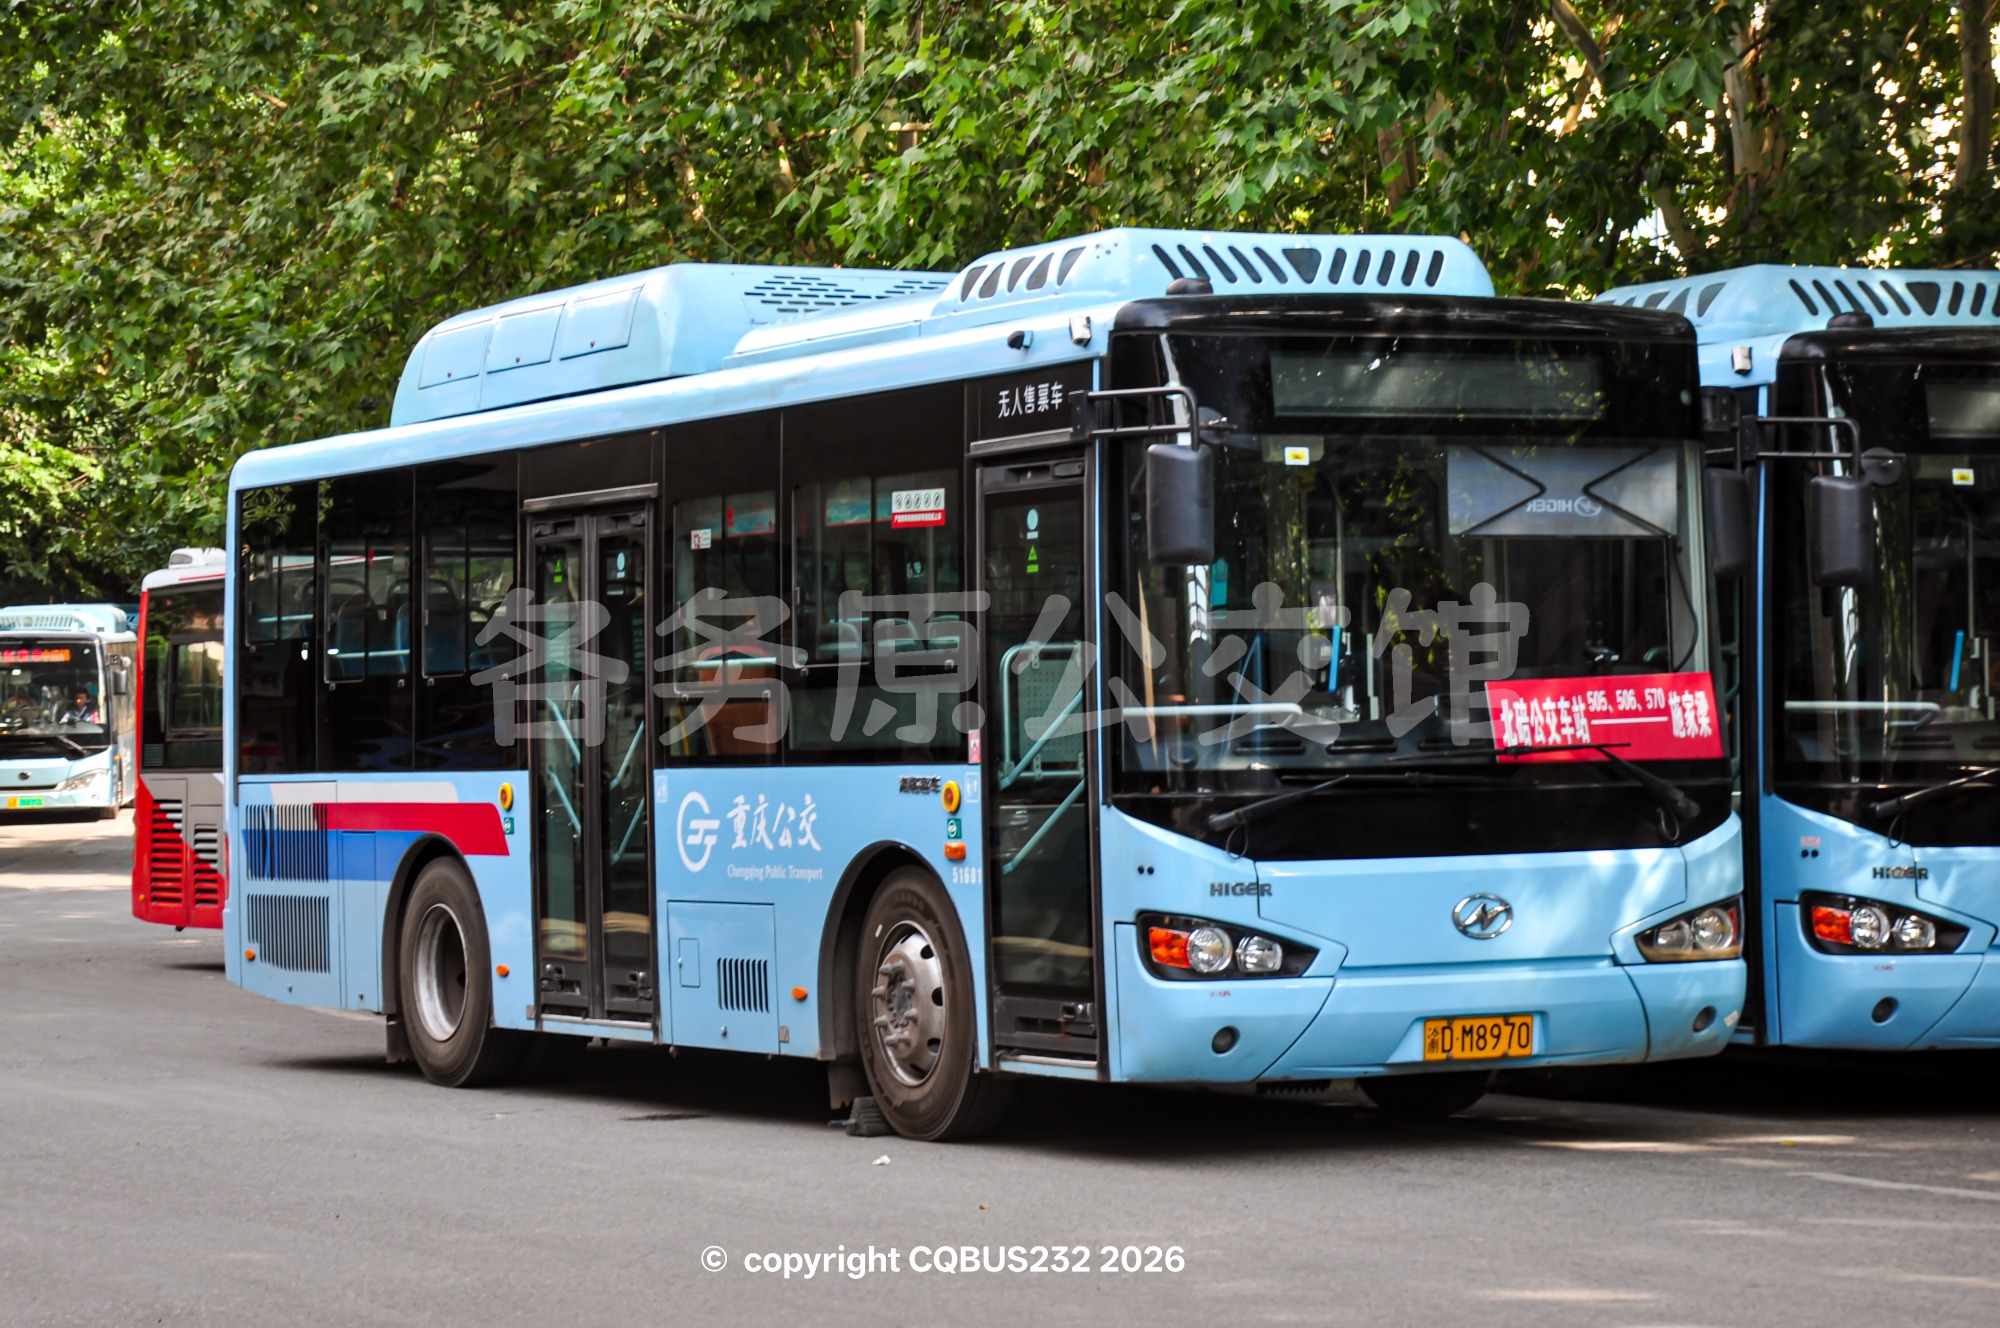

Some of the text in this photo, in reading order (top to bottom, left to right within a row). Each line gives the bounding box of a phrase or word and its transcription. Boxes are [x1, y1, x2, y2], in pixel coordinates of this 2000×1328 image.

[998, 381, 1063, 418] 无人售票车
[1500, 695, 1591, 747] 北碚公交车站
[726, 793, 822, 852] 重庆公交
[765, 865, 787, 879] Public
[788, 865, 823, 882] Transport
[1872, 866, 1929, 880] HIGER
[1209, 882, 1273, 897] HIGER
